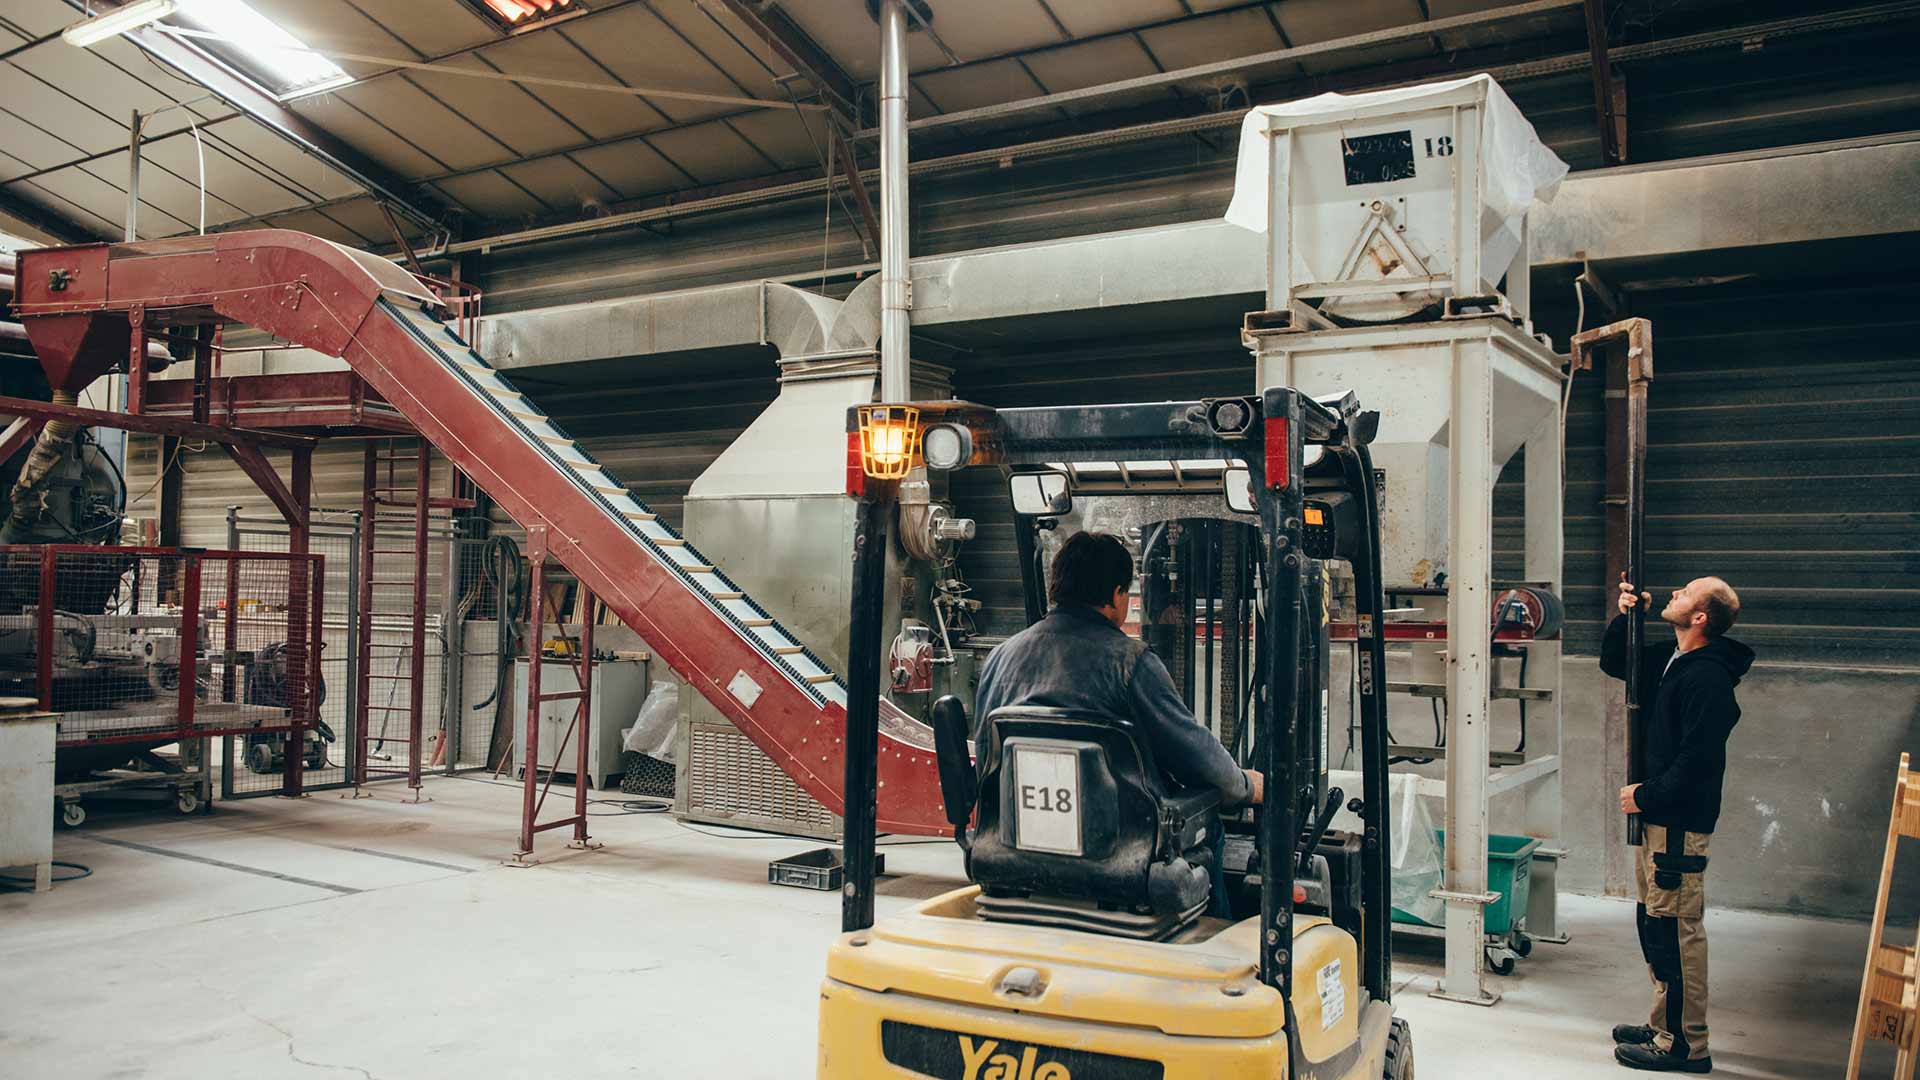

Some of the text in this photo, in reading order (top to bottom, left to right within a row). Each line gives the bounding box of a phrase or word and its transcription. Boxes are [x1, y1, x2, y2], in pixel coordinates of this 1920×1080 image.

[1424, 136, 1454, 158] 18
[1021, 785, 1072, 813] E18
[958, 1034, 1071, 1080] Yale
